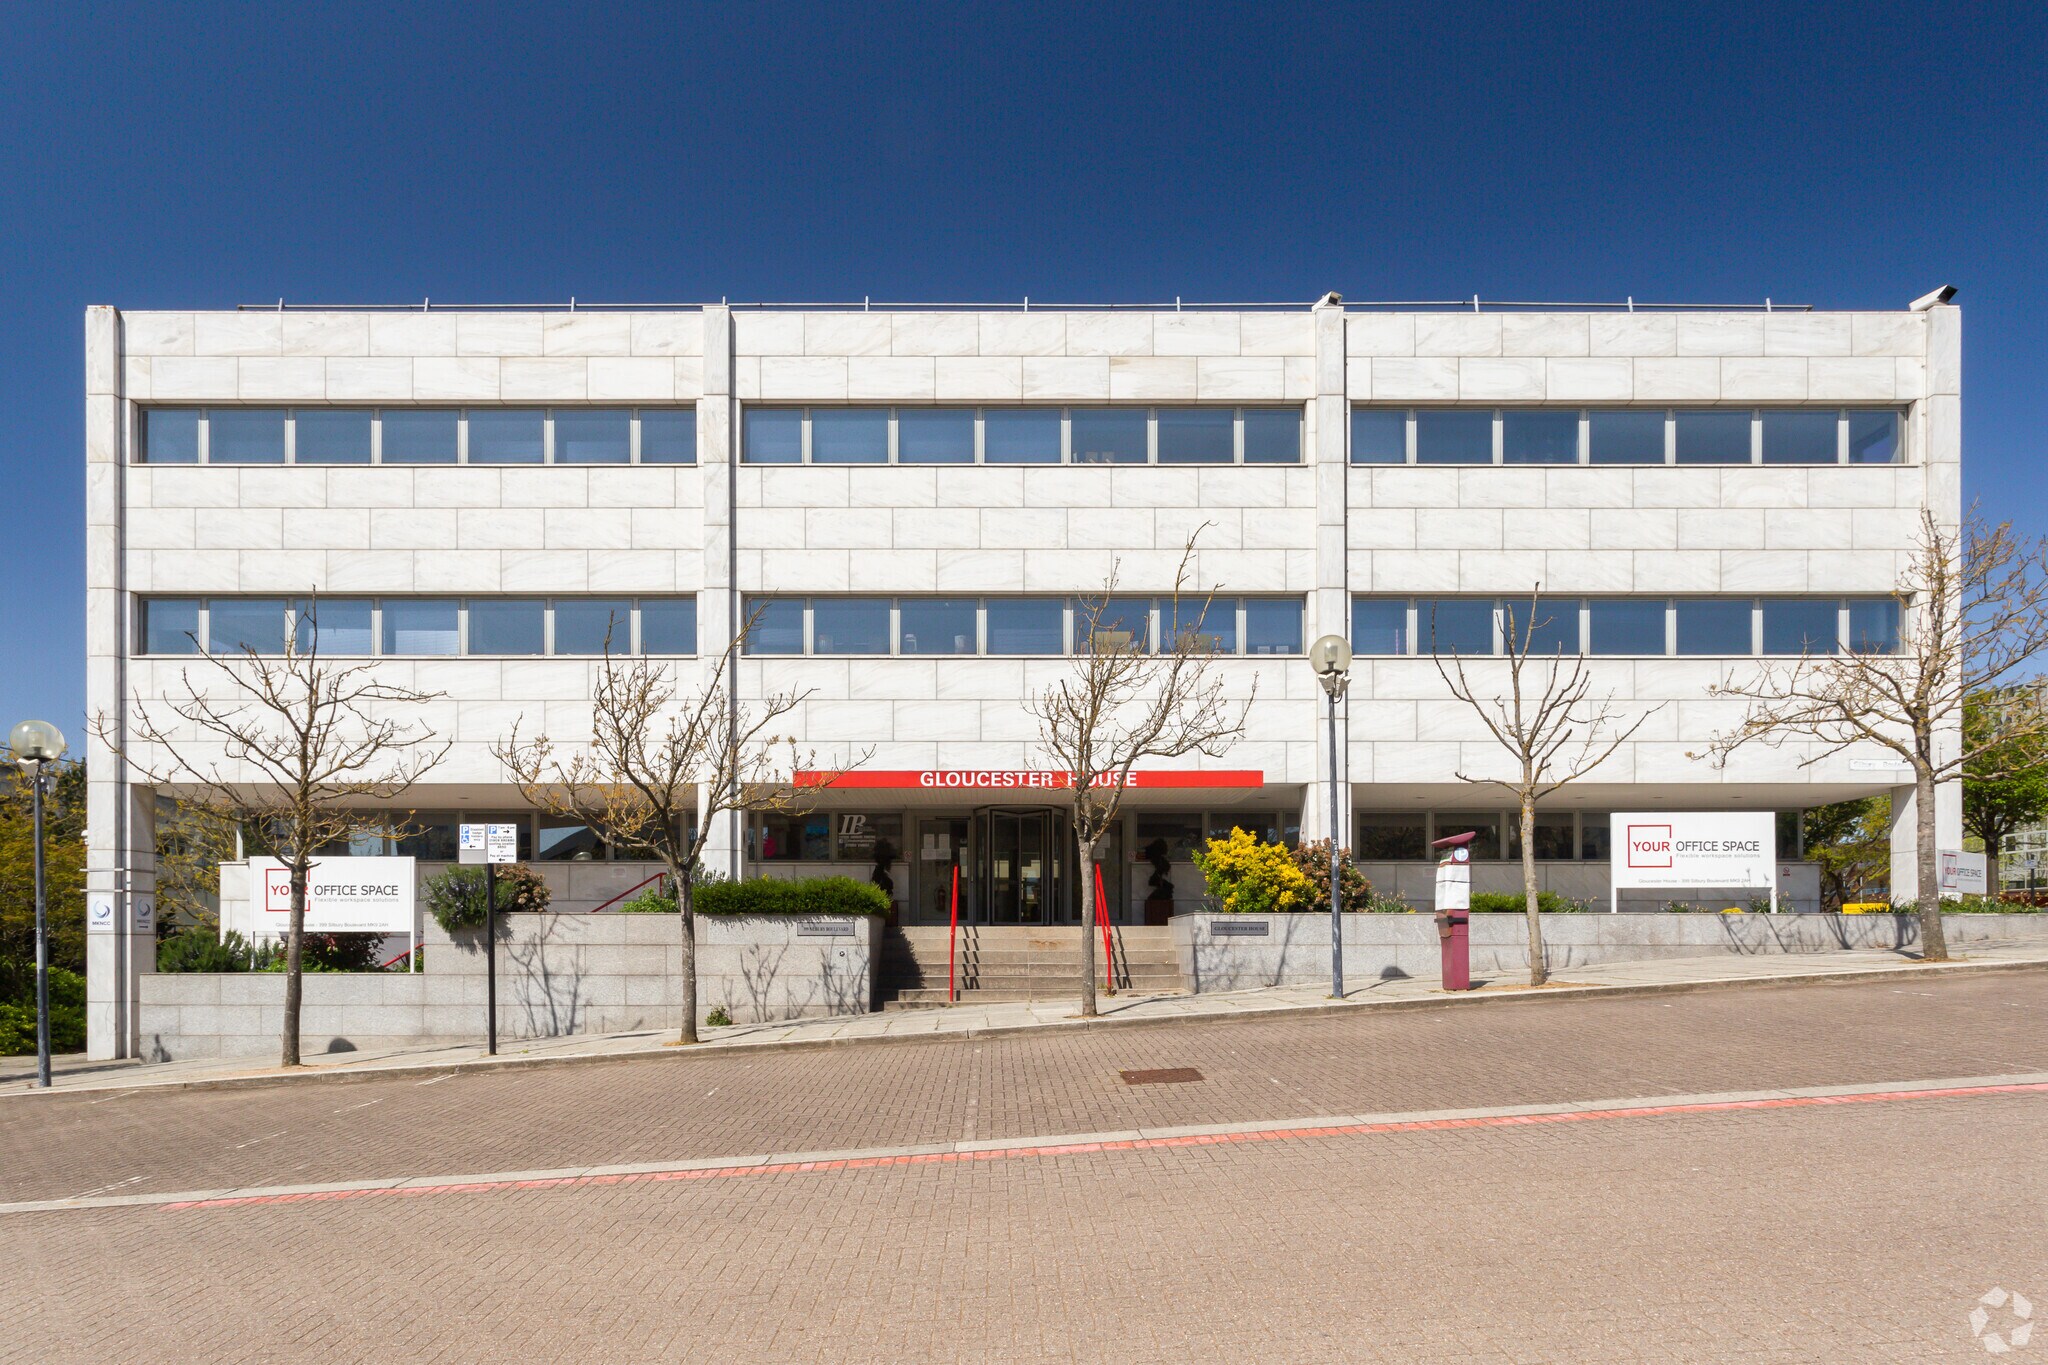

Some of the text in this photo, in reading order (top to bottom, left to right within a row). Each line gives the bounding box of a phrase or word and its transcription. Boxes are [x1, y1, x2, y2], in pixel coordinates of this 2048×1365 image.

[920, 772, 1053, 787] GLOUCESTER
[1633, 841, 1760, 852] YOUR OFFICE SPACE
[271, 885, 399, 896] YOR OFFICE SPACE
